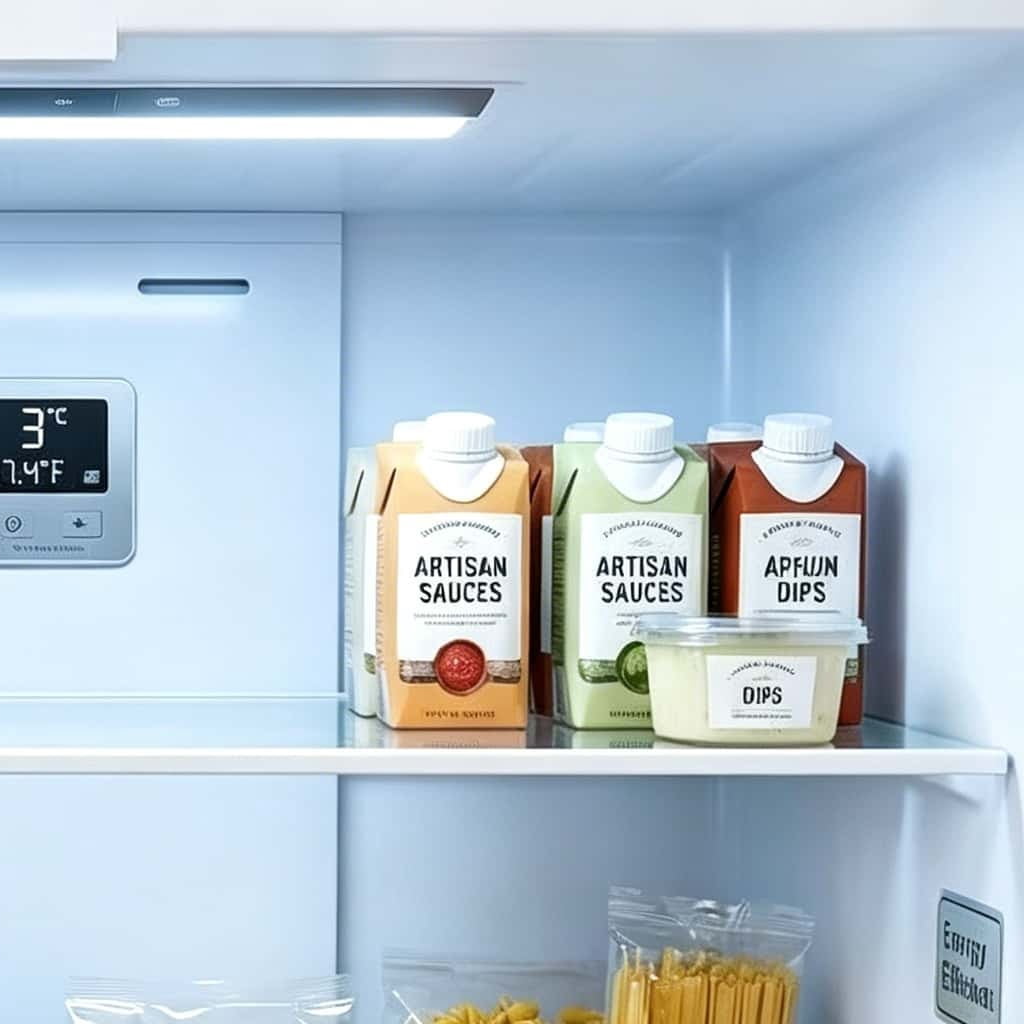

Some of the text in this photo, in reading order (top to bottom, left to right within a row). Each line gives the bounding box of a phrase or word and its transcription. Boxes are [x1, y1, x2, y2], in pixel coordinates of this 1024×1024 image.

[414, 556, 507, 577] ARTISAN
[596, 556, 688, 578] ARTISAN
[419, 582, 503, 603] SAUCES
[601, 582, 684, 603] SAUCES
[777, 581, 826, 603] DIPS
[743, 686, 782, 705] DIPS
